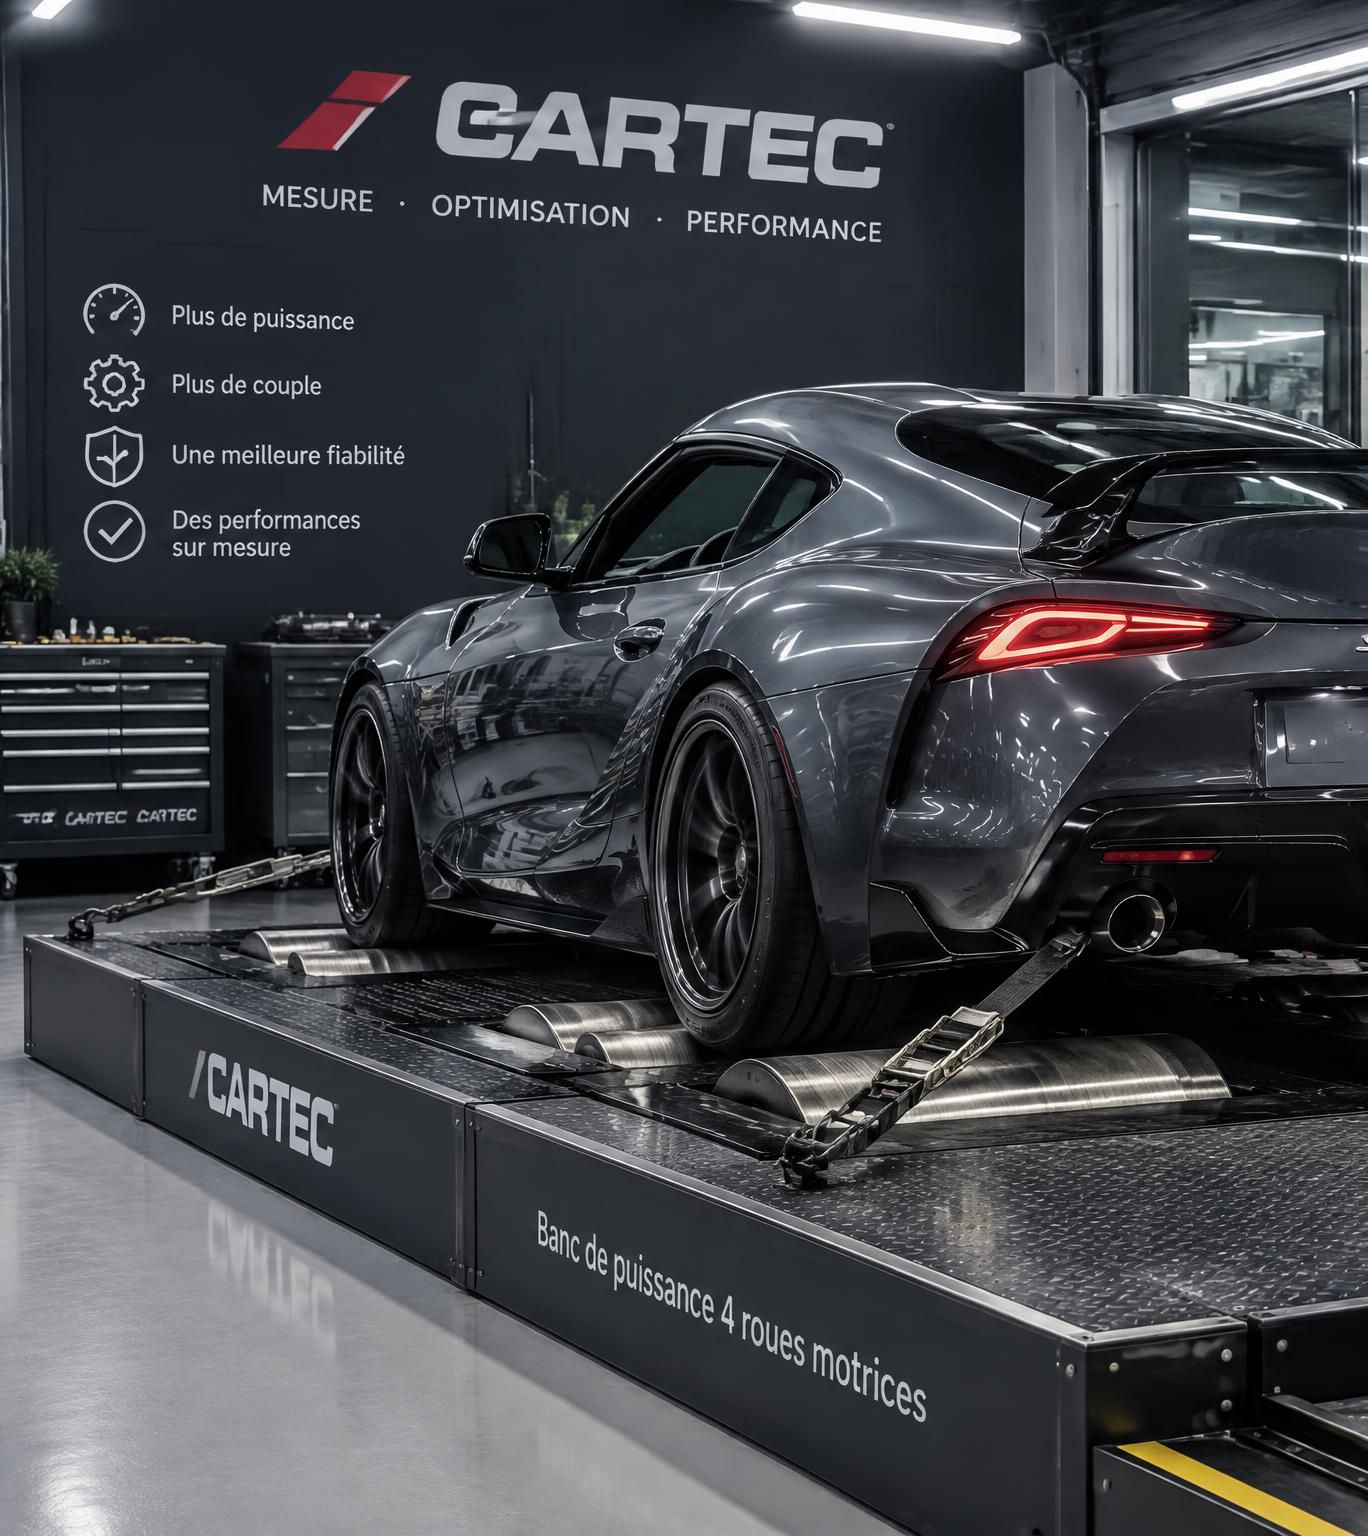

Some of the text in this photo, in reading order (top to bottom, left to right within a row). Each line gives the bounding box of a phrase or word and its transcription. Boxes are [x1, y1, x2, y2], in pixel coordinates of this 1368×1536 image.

[436, 82, 883, 188] CARTEC
[263, 184, 881, 242] MESURE OPTIMISATION PERFORMANCE
[173, 305, 354, 332] Plus de puissance
[173, 373, 321, 399] Plus de couple
[173, 445, 404, 465] Une meilleure fiabilité
[174, 509, 360, 534] Des performances
[173, 542, 290, 556] sur mesure
[538, 1210, 926, 1422] Banc de puissance 4 roues motrices
